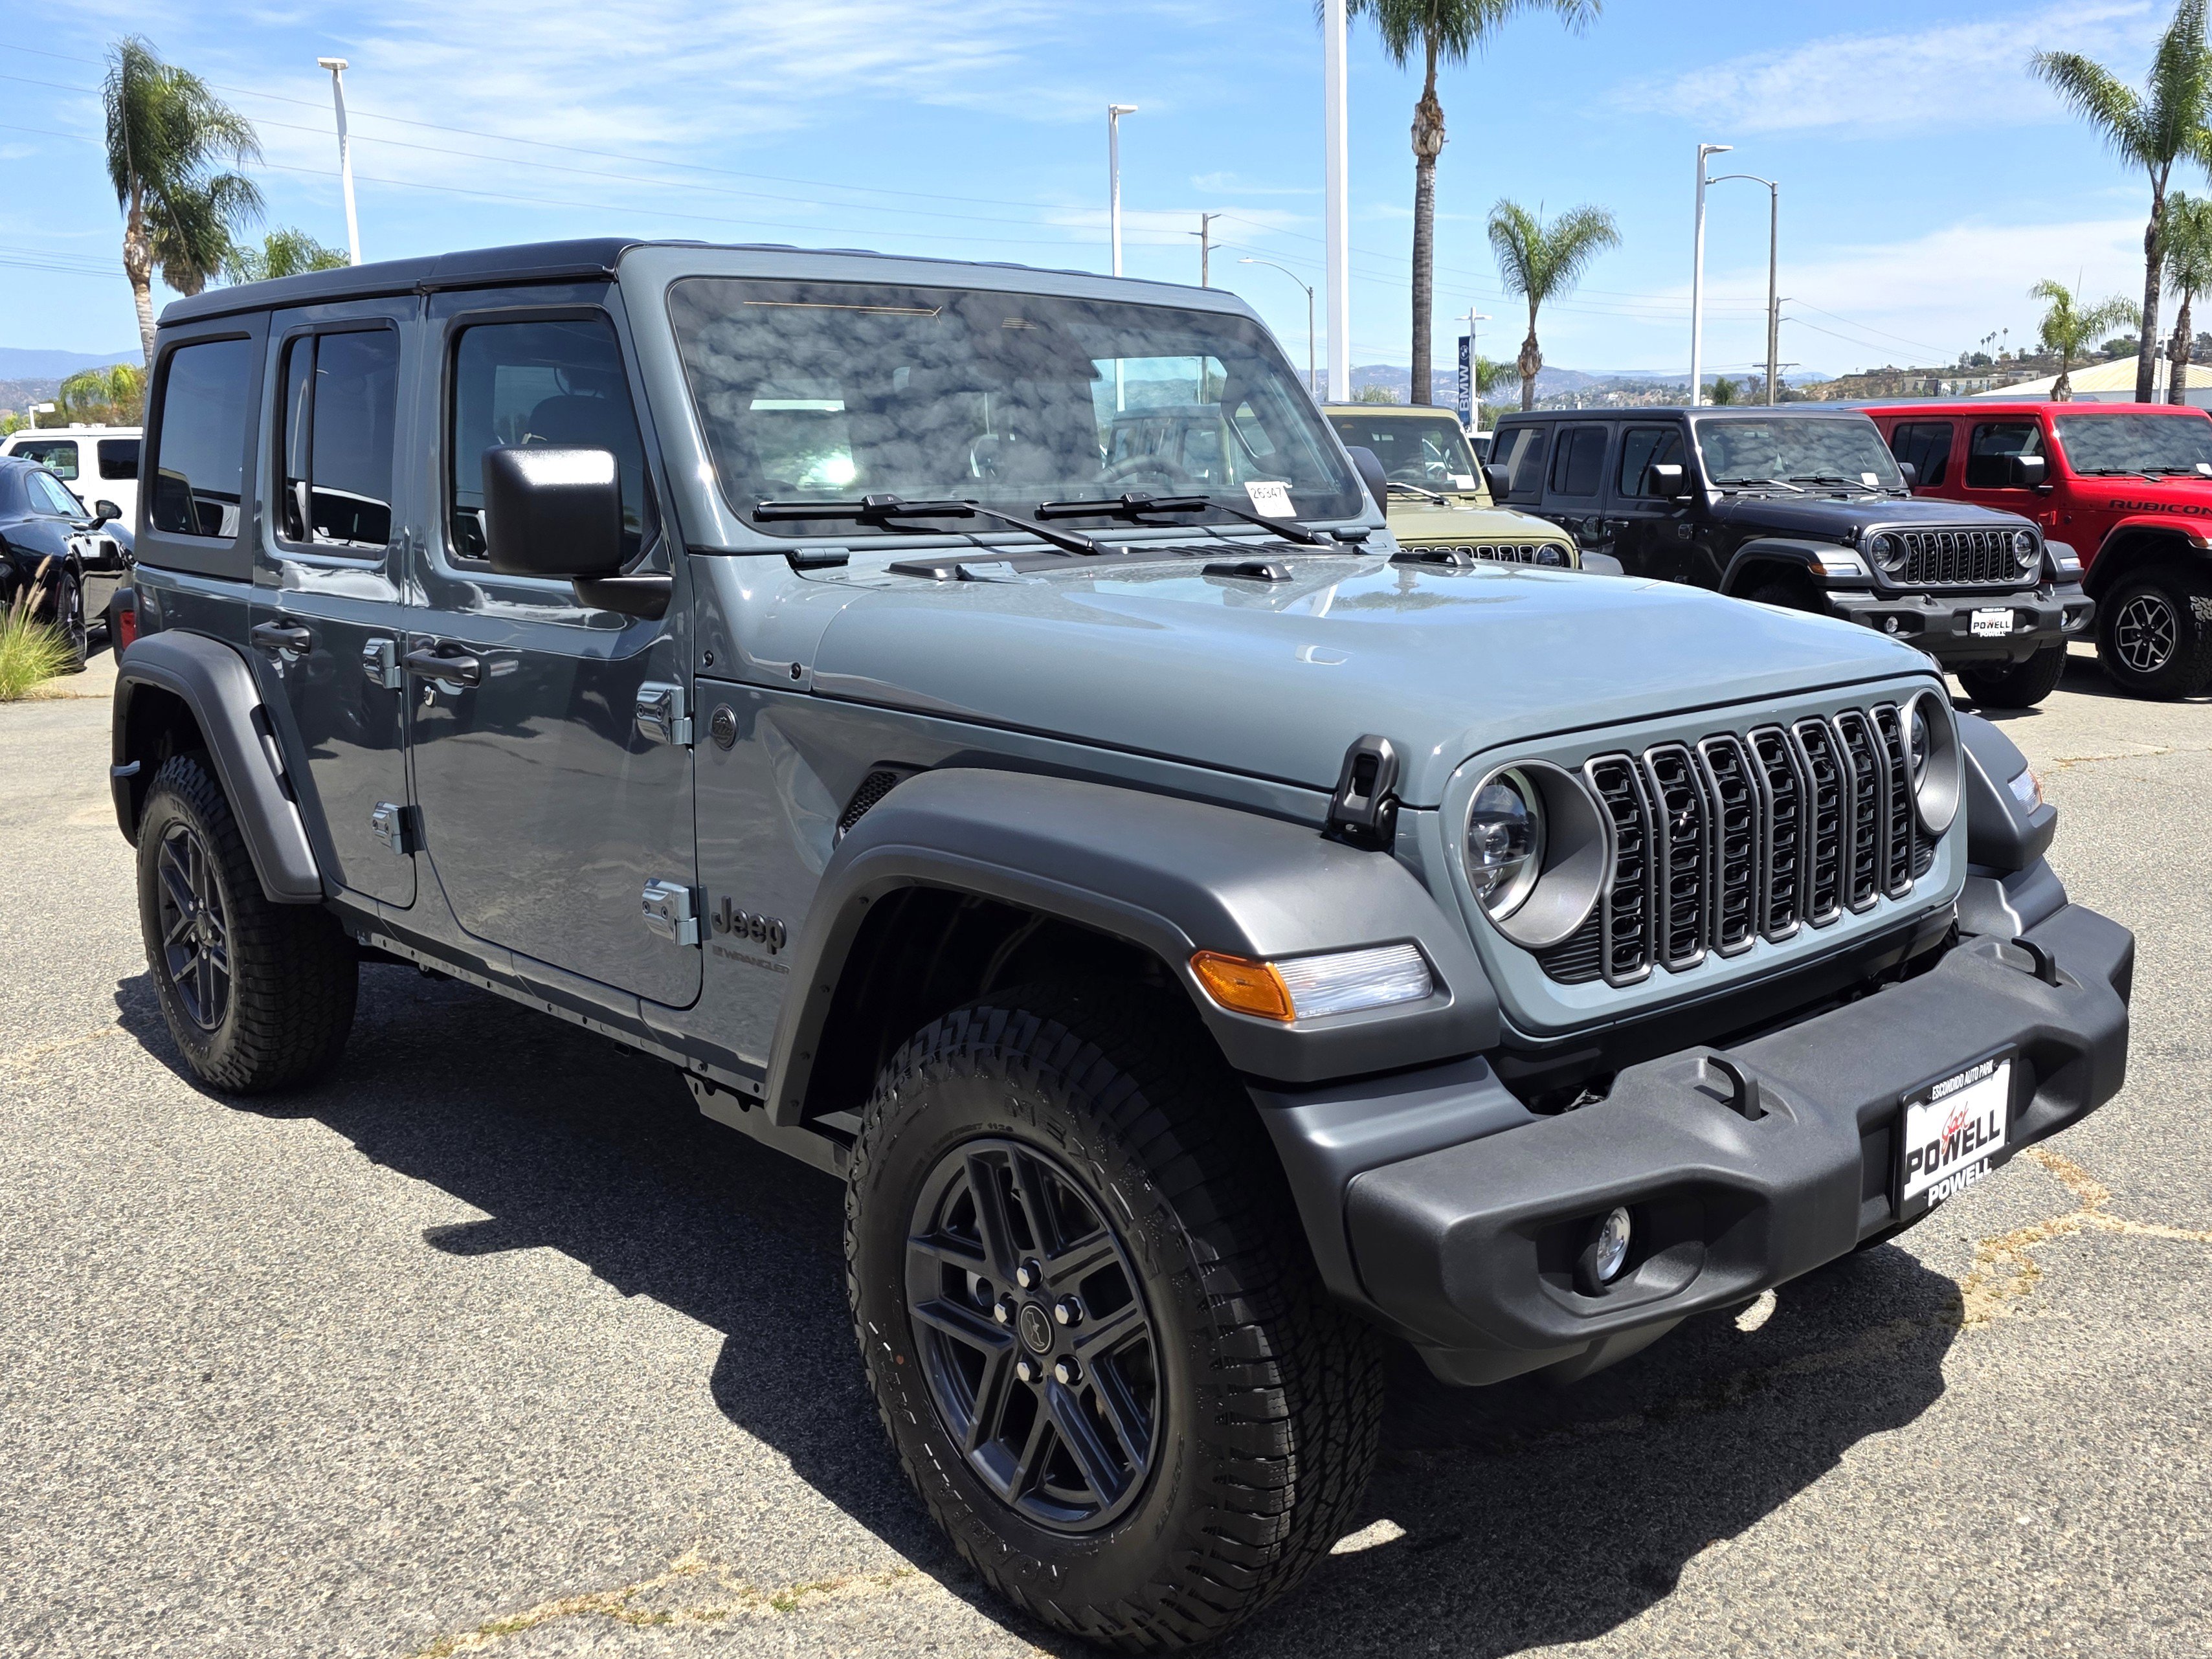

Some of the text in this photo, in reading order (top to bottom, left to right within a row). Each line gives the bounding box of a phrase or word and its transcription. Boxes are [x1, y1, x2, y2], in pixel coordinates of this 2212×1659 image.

[1459, 364, 1469, 412] BMW
[1250, 487, 1282, 499] 26347
[2109, 499, 2212, 515] RUBICON
[1973, 621, 2010, 630] POWELL
[711, 895, 787, 955] Jeep
[1932, 1059, 1994, 1100] ESCONDIDO AUTO PARK
[1906, 1109, 2000, 1183] POWELL
[1941, 1101, 1971, 1155] Jack
[1928, 1157, 1992, 1207] POWELL
